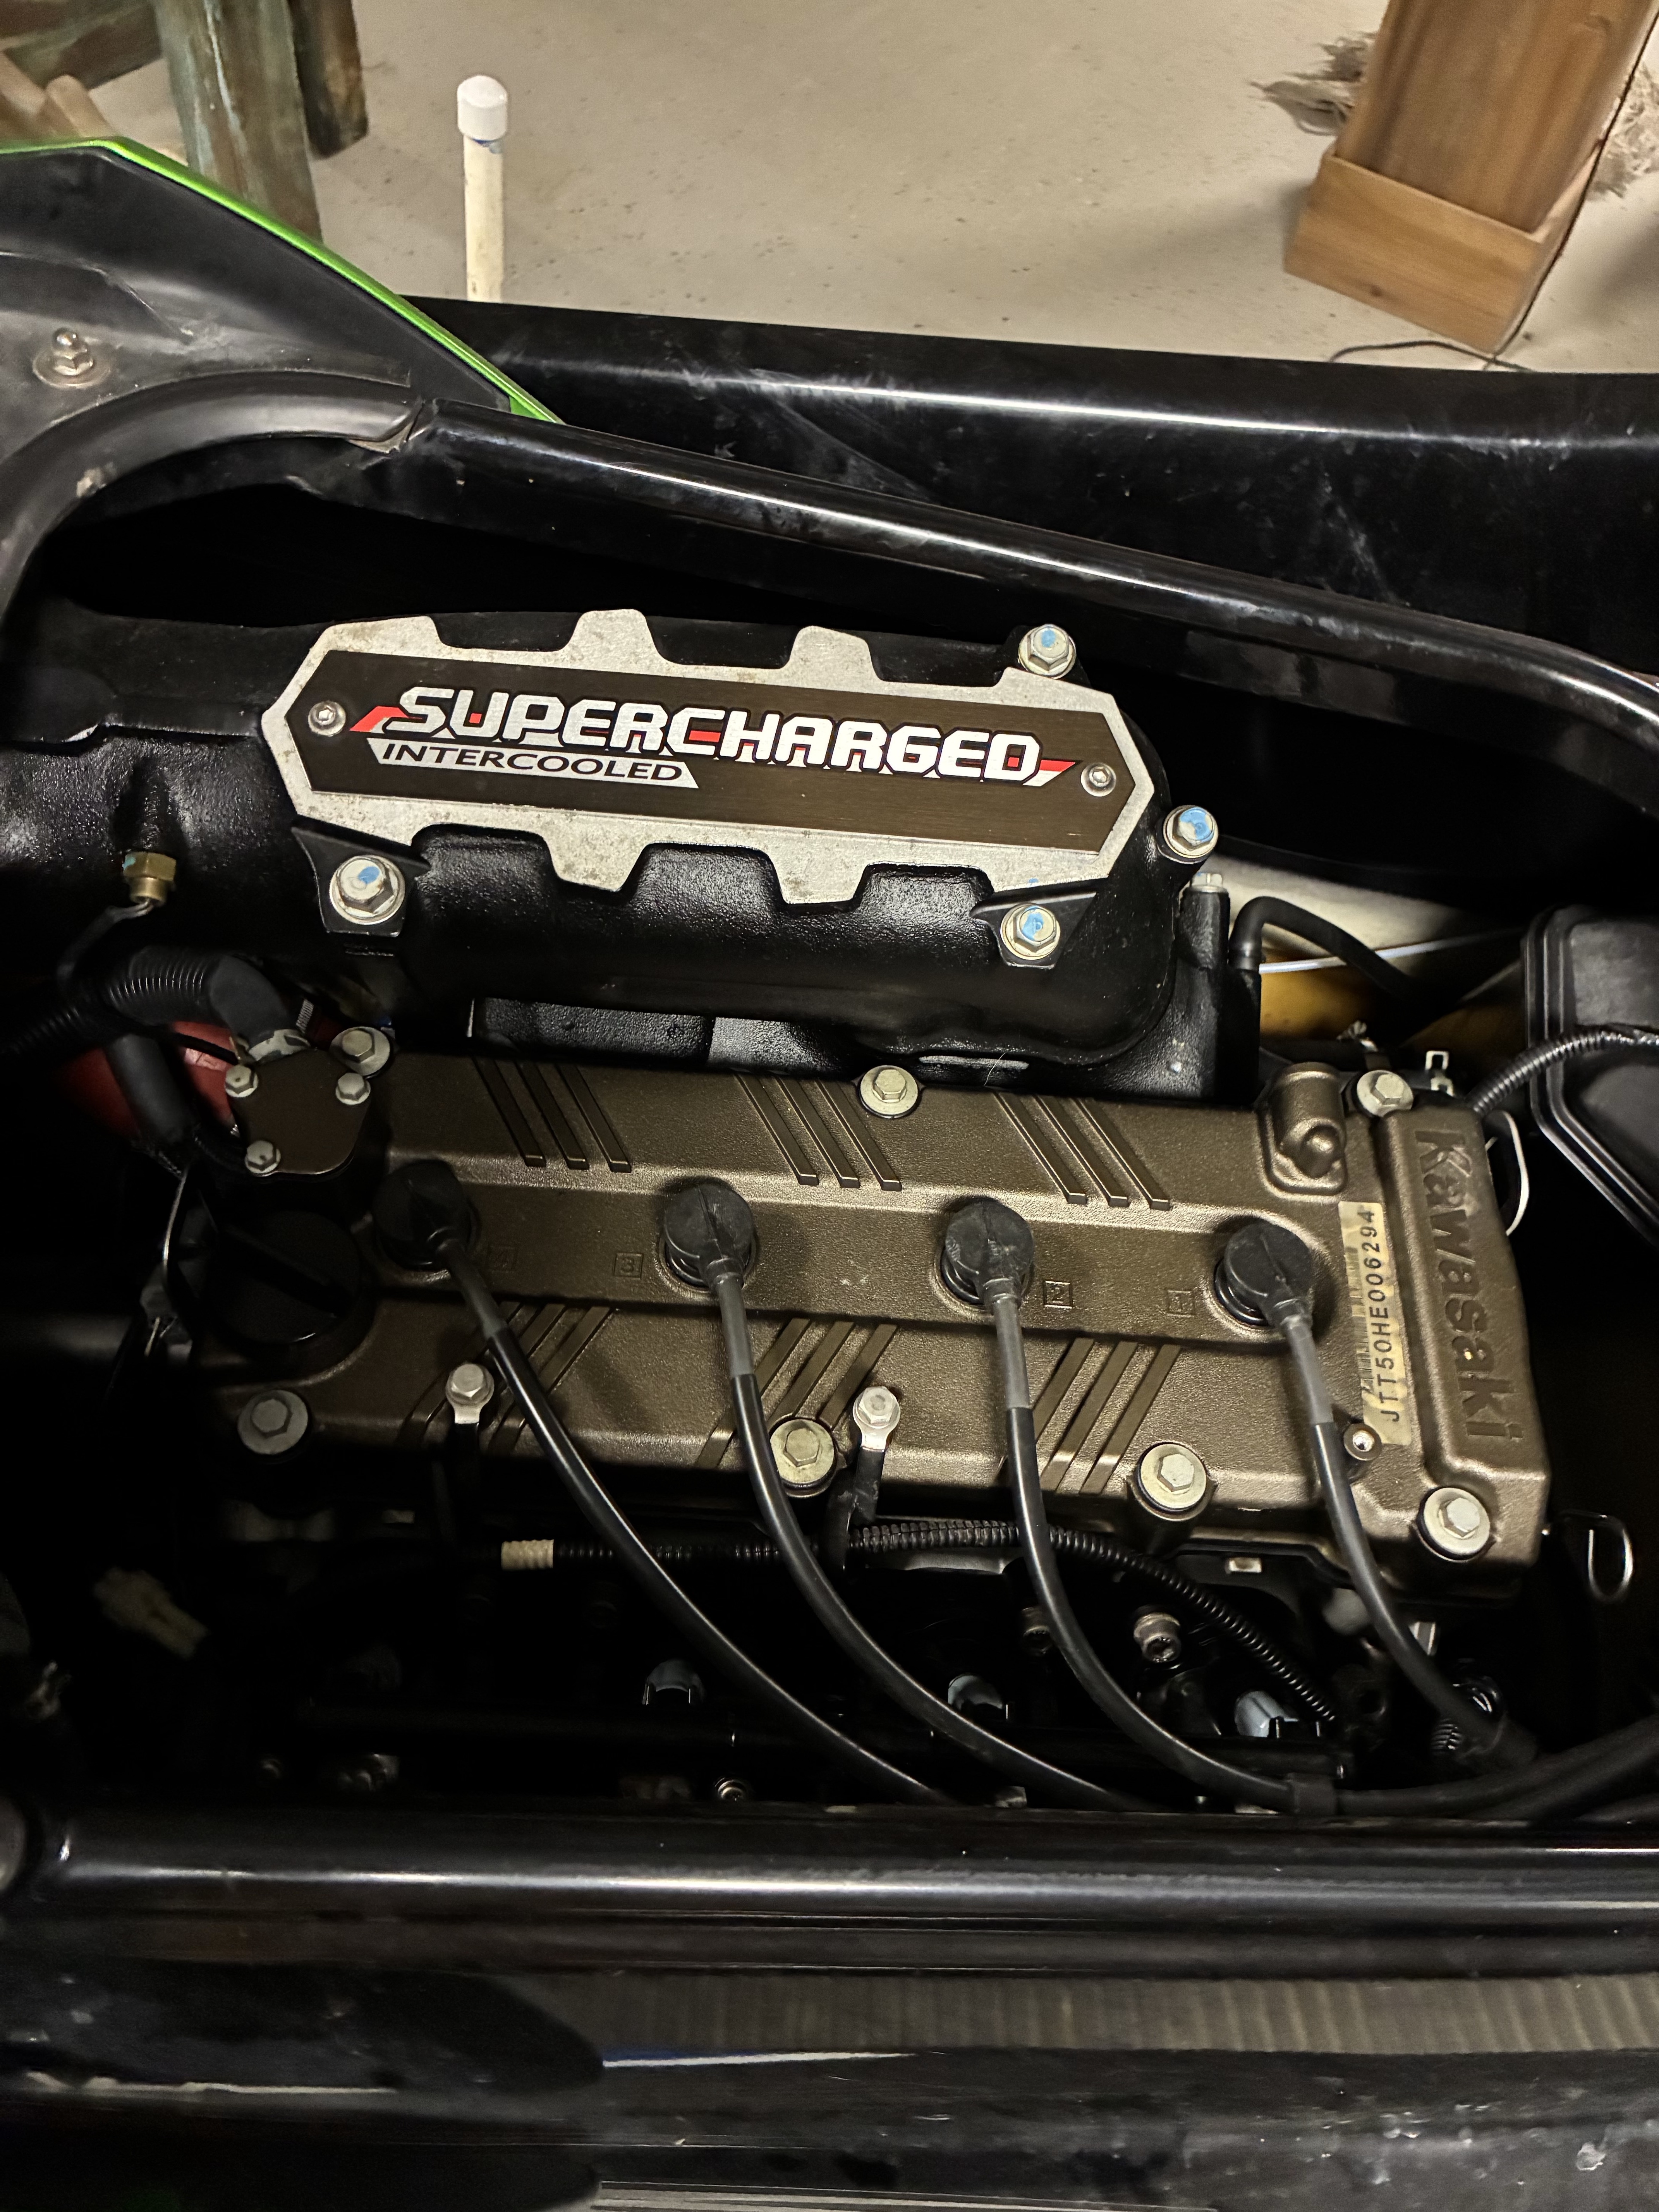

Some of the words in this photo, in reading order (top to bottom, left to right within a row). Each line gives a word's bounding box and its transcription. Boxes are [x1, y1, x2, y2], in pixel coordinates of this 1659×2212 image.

[382, 742, 682, 781] INTERCOOLED
[385, 686, 1042, 781] SUPERCHARGED
[1050, 1284, 1065, 1303] 2
[1415, 1130, 1524, 1439] Kawasaki
